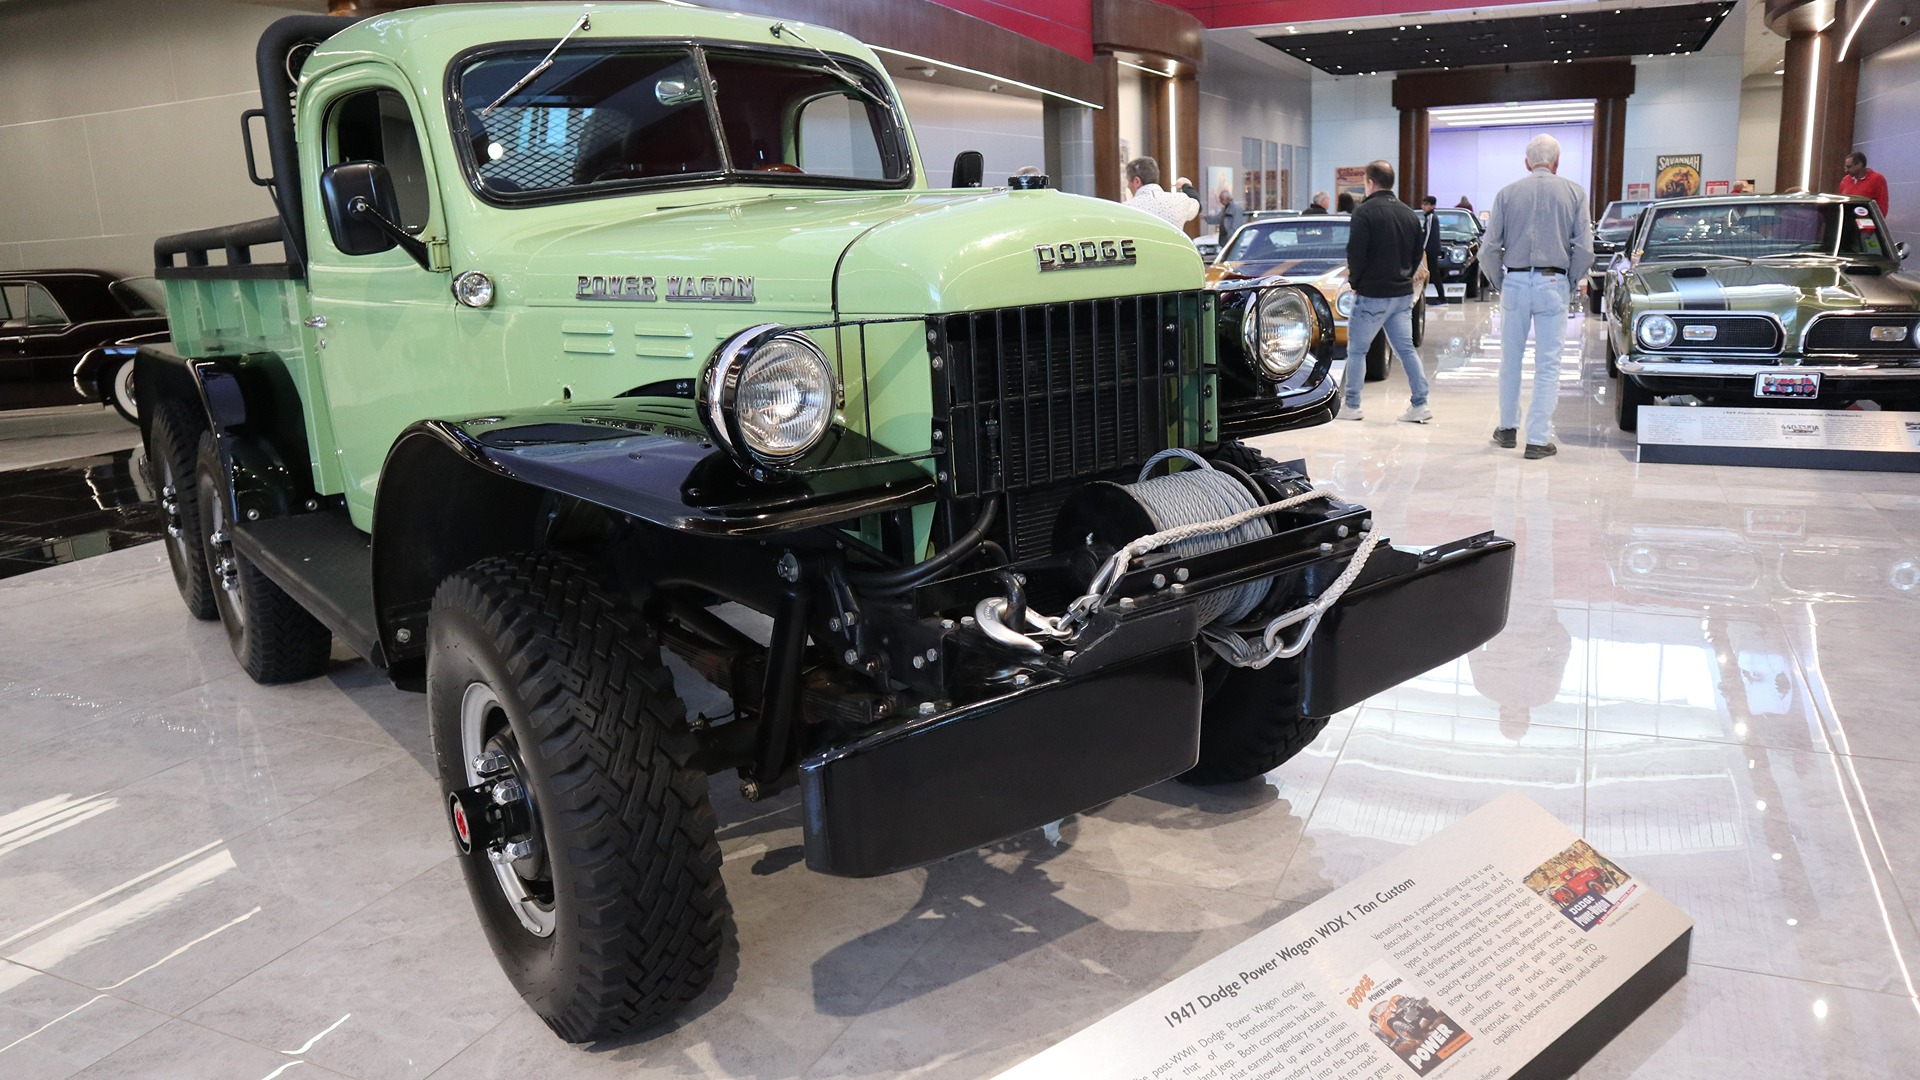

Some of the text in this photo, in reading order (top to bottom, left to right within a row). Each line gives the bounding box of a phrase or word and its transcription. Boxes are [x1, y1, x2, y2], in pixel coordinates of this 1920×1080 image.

[1658, 155, 1700, 171] SAVANNAH
[1034, 240, 1136, 266] DODGE
[577, 275, 755, 299] POWER WAGON
[1370, 921, 1404, 941] Versatility
[1401, 914, 1415, 924] was
[1418, 893, 1444, 915] powerful
[1442, 884, 1463, 898] selling
[1458, 876, 1472, 888] tool
[1482, 863, 1495, 872] was
[1382, 928, 1413, 951] described
[1413, 924, 1422, 932] in
[1419, 906, 1452, 926] brochures
[1459, 892, 1472, 901] the
[1490, 873, 1498, 882] of
[1393, 938, 1422, 960] thousand
[1435, 913, 1460, 931] Original
[1458, 906, 1473, 918] sales
[1471, 893, 1494, 909] manuals
[1489, 882, 1508, 896] listed
[1503, 878, 1514, 887] 75
[1568, 895, 1595, 915] DODGE
[1164, 878, 1416, 1028] 1947 Dodge Power Wagon WDX 1 Ton Custom
[1403, 955, 1422, 970] types
[1422, 947, 1431, 957] of
[1428, 930, 1461, 952] businesses
[1460, 916, 1484, 932] ranging
[1478, 906, 1496, 918] from
[1494, 892, 1517, 908] airports
[1414, 896, 1532, 978] well drillers as prospects for the Power Wagon.
[1423, 979, 1436, 988] Its
[1434, 955, 1468, 980] four-wheel
[1467, 946, 1485, 958] drive
[1482, 938, 1495, 947] for
[1501, 916, 1524, 935] nominal
[1523, 903, 1545, 919] one-ton
[1436, 978, 1462, 997] capacity
[1459, 964, 1479, 980] would
[1477, 954, 1495, 968] carry
[1497, 935, 1521, 953] through
[1518, 927, 1534, 938] deep
[1532, 917, 1546, 929] mud
[1543, 910, 1556, 921] and
[1447, 920, 1566, 1007] snow. Countless chassis configurations were
[1458, 1001, 1475, 1017] used
[1474, 989, 1494, 1003] from
[1495, 973, 1516, 991] pickup
[1517, 961, 1530, 973] and
[1531, 948, 1547, 964] panel
[1548, 935, 1567, 950] trucks
[1469, 937, 1589, 1026] ambulances, tow trucks, school buses,
[1574, 965, 1591, 982] useful
[1588, 954, 1609, 970] vehicle.
[1346, 974, 1375, 1009] DODGE
[1367, 977, 1403, 1003] POWER-WAGON
[1479, 943, 1598, 1036] firetrucks, and fuel trucks. With its PTO
[1522, 1002, 1547, 1021] became
[1548, 978, 1578, 1002] universally
[1151, 981, 1306, 1079] post-WWII Dodge Power Wagon closely
[1182, 991, 1317, 1076] that of its brother-in-arms, the
[1214, 1059, 1235, 1076] Jeep.
[1237, 1043, 1260, 1059] Both
[1259, 1020, 1297, 1046] companies
[1293, 1009, 1311, 1023] had
[1307, 1000, 1327, 1014] built
[1247, 1050, 1274, 1071] earned
[1271, 1030, 1309, 1055] legendary
[1307, 1016, 1330, 1033] status
[1326, 1011, 1338, 1019] in
[1285, 1055, 1298, 1065] up
[1298, 1042, 1316, 1056] with
[1324, 1021, 1349, 1039] civilian
[1492, 1023, 1522, 1046] capability,
[1518, 1018, 1527, 1026] it
[1310, 1055, 1325, 1067] out
[1323, 1046, 1333, 1058] of
[1331, 1031, 1360, 1052] uniform
[1332, 1058, 1347, 1070] the
[1344, 1042, 1371, 1060] Dodge
[1408, 1023, 1454, 1070] POWER
[1346, 1068, 1359, 1079] no
[1374, 1062, 1394, 1080] great
